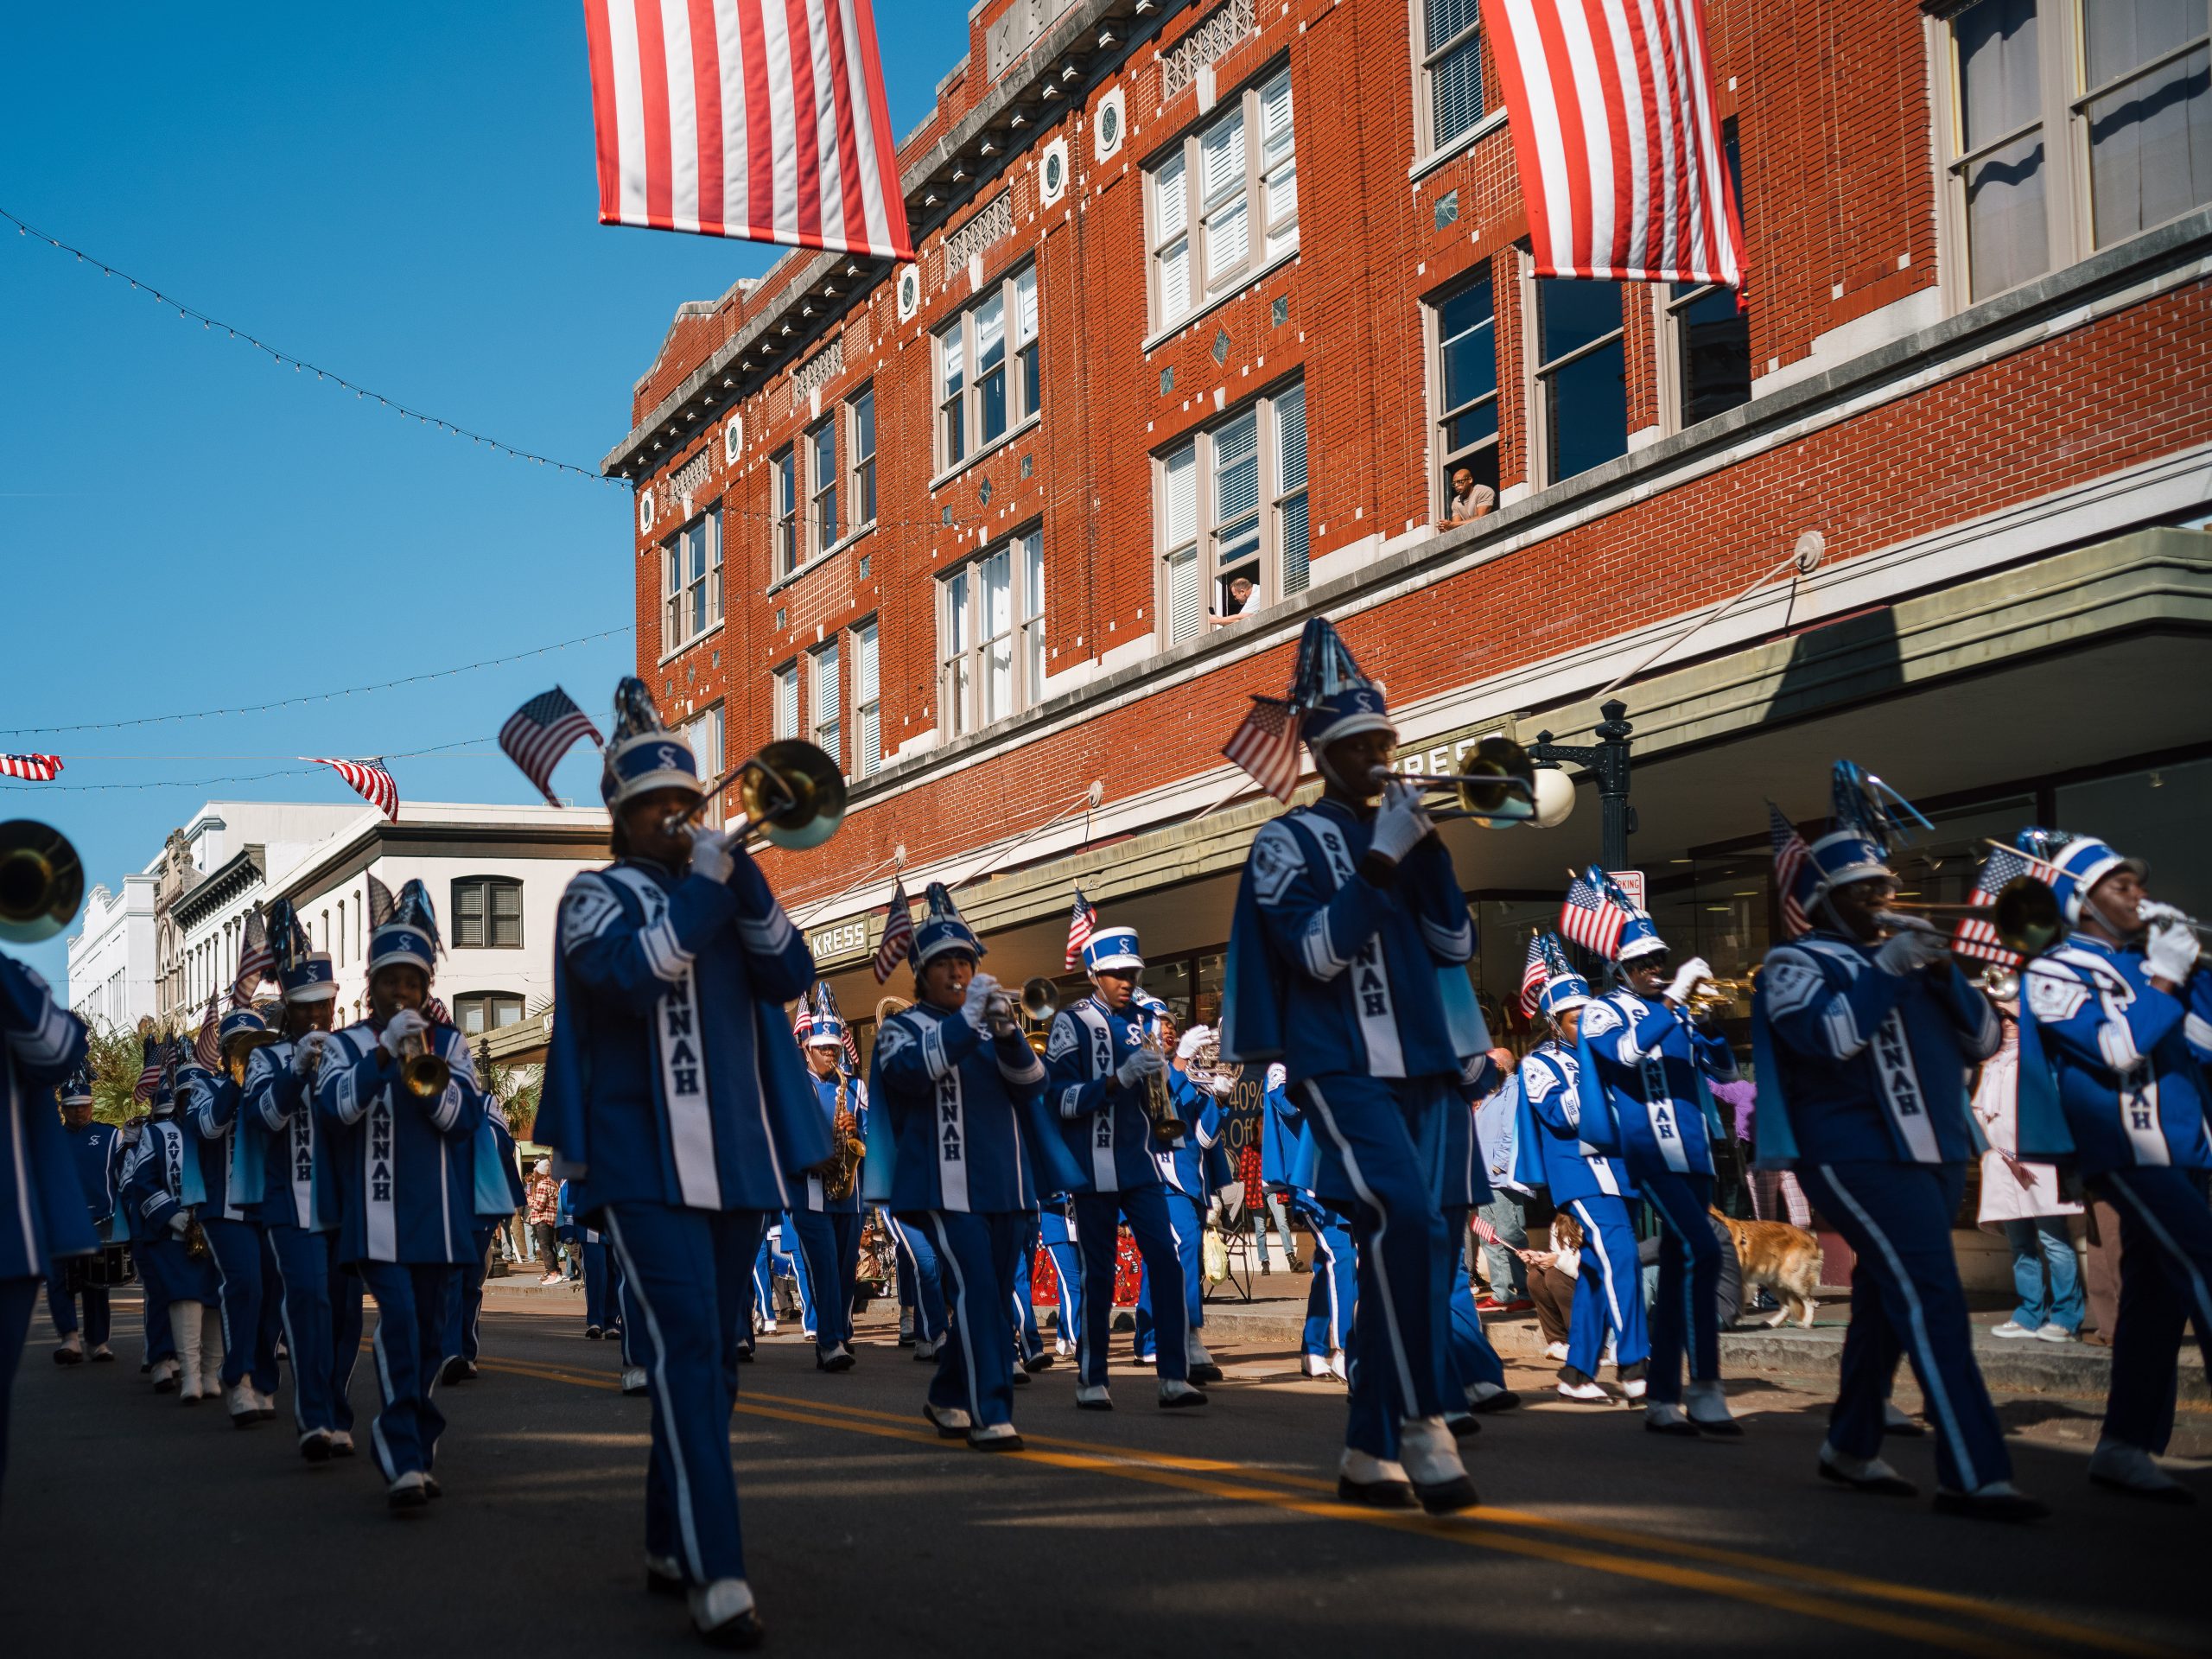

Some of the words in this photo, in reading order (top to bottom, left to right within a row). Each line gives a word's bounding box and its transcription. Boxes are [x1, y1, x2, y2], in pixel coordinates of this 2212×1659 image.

[1617, 879, 1639, 889] RKING
[812, 923, 864, 958] KRESS
[939, 1071, 961, 1161] ANNAH
[1230, 1118, 1255, 1148] Off
[372, 1101, 391, 1201] ANNAH
